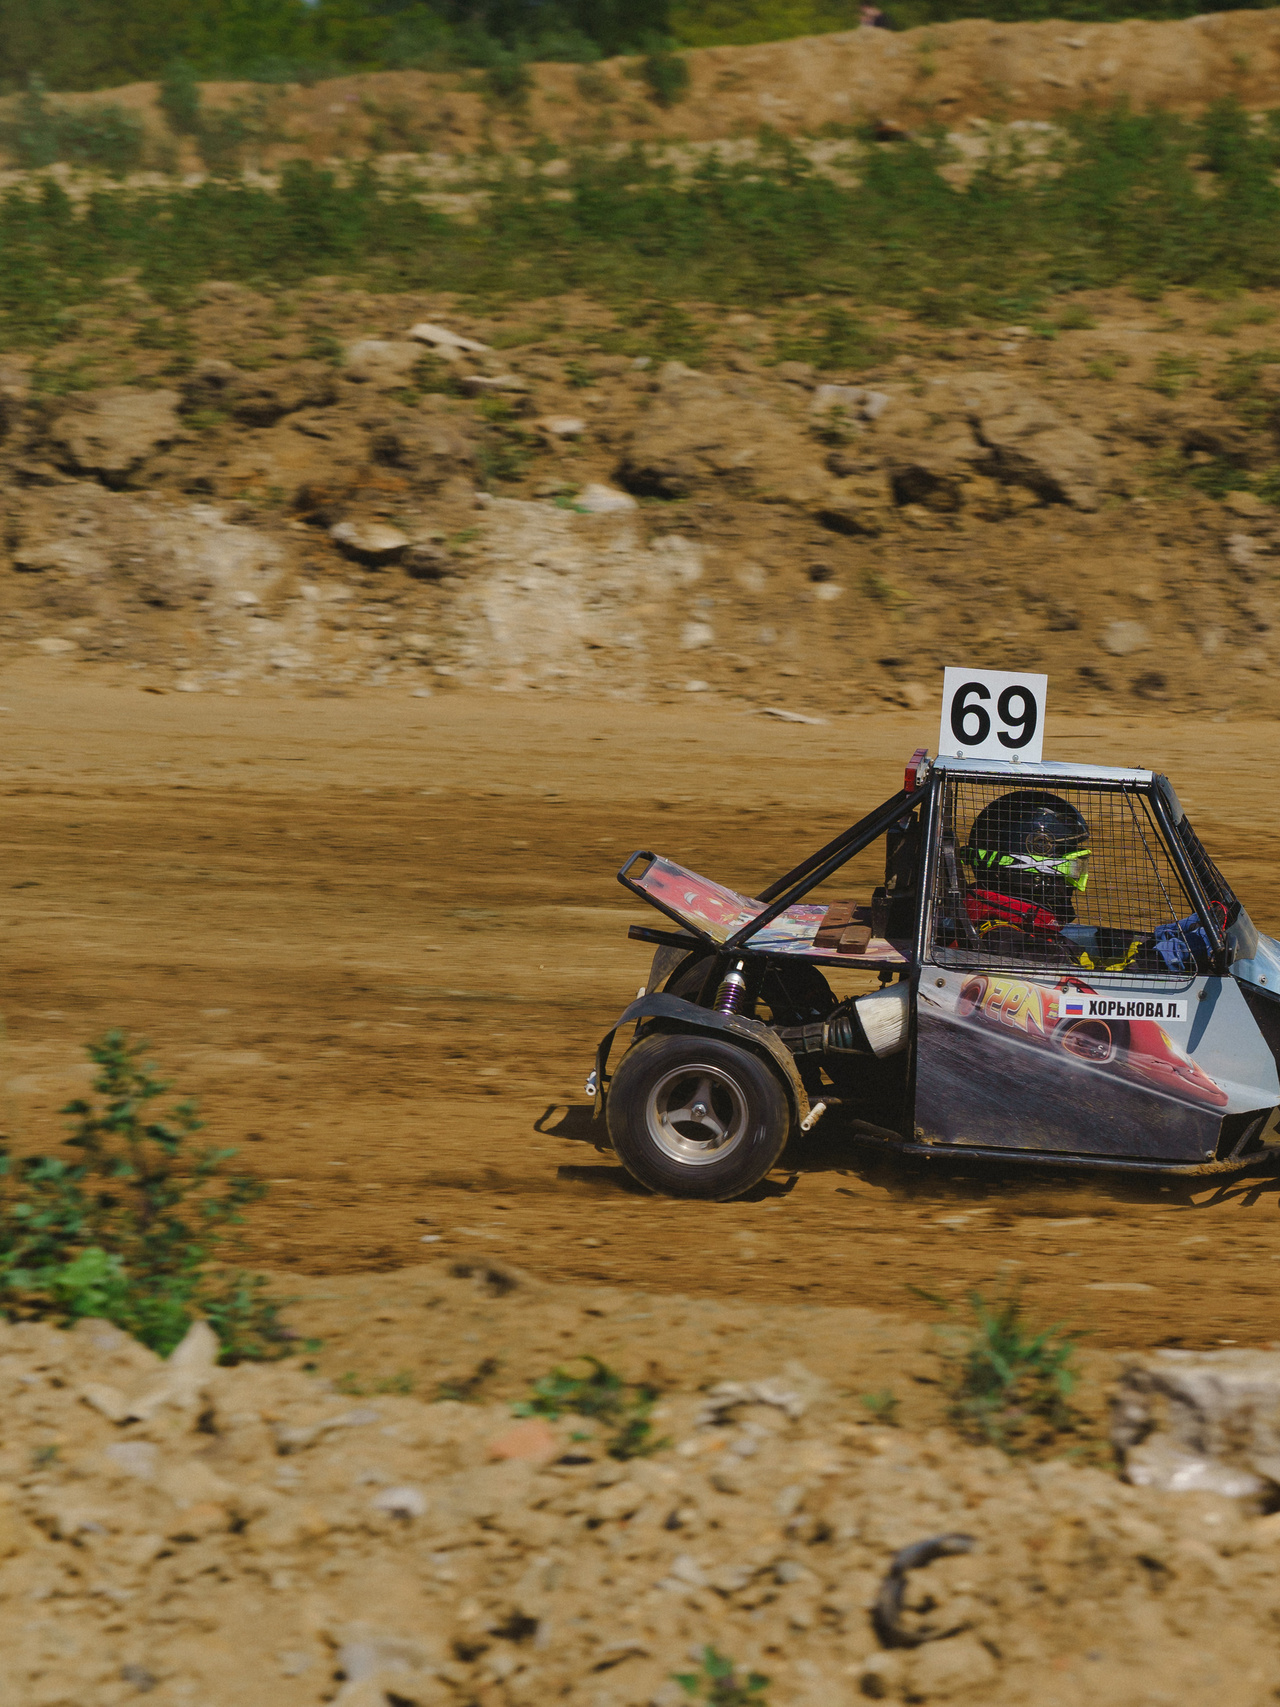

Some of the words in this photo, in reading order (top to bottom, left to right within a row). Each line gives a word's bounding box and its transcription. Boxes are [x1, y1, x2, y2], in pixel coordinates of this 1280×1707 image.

[950, 681, 1038, 749] 69
[1088, 1000, 1164, 1018] ХОРЬКОВА
[1166, 1002, 1180, 1019] Л.
